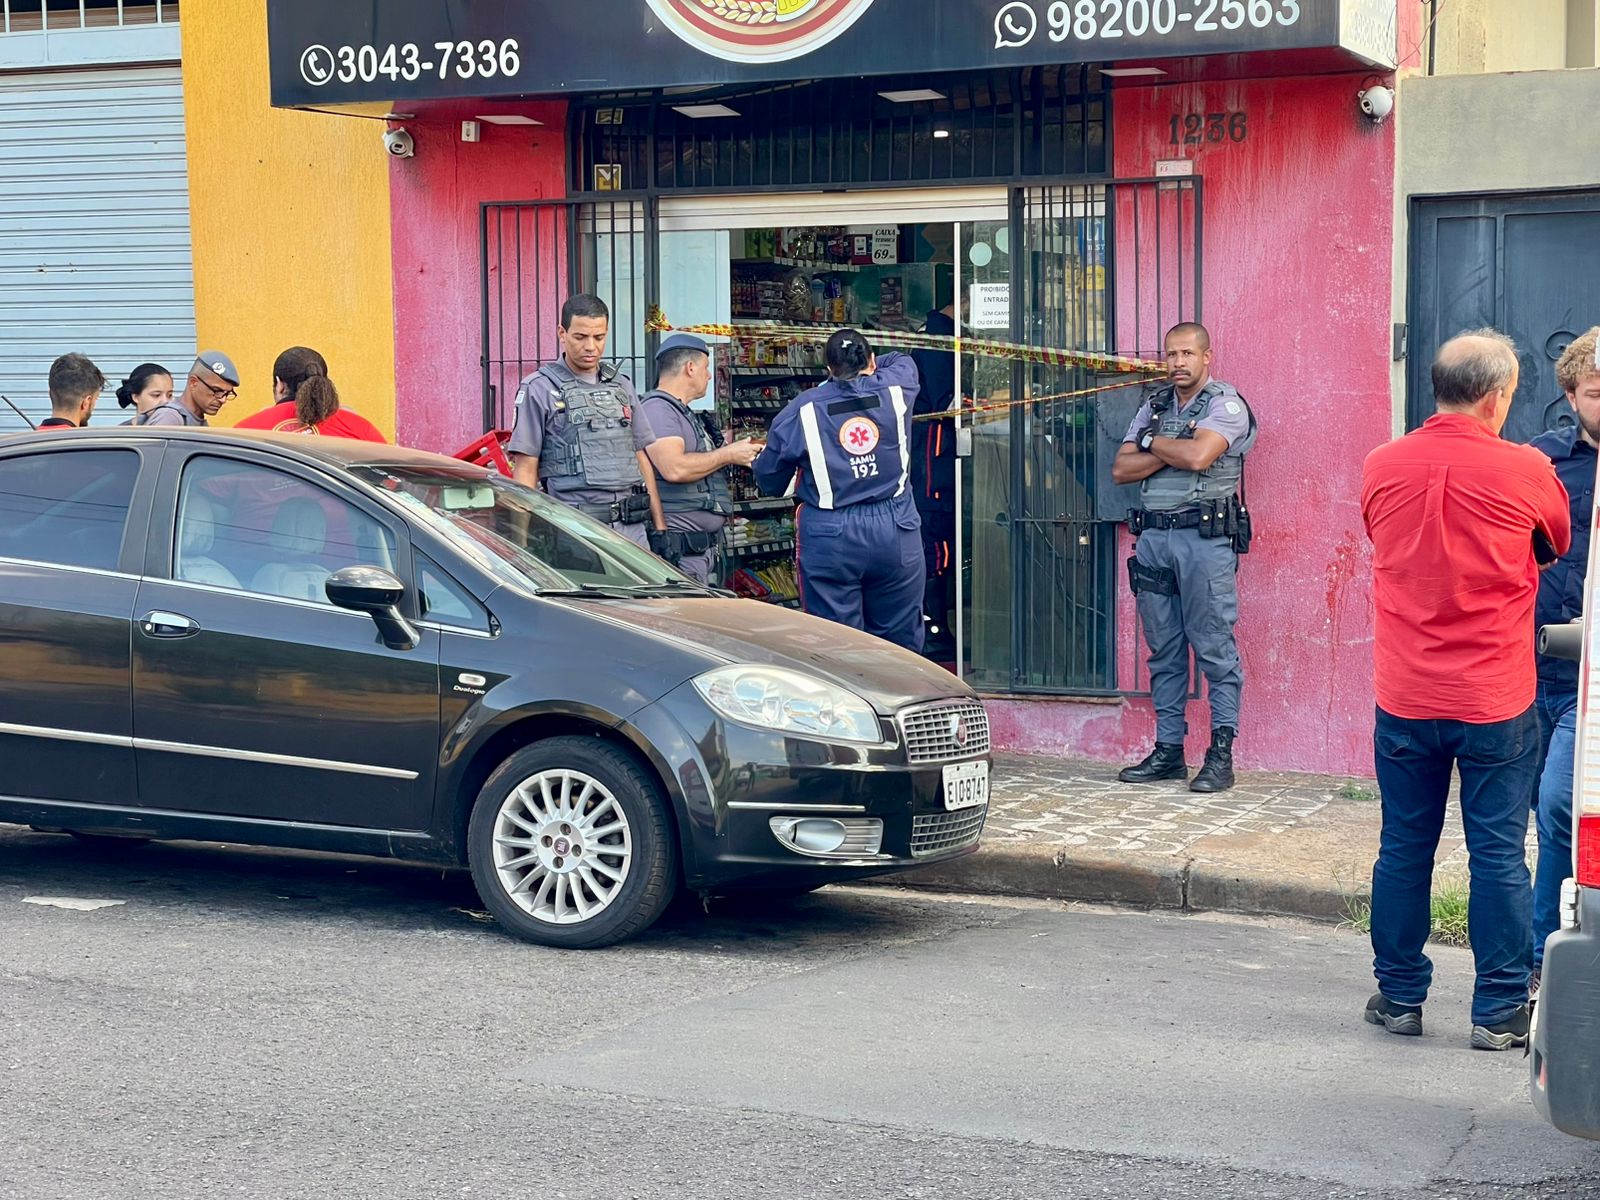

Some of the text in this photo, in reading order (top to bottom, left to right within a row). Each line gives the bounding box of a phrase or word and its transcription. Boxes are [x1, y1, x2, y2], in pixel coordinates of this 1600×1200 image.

[1047, 0, 1300, 42] 98200-2563
[337, 38, 520, 83] 3043-7336
[1169, 113, 1247, 145] 1236
[849, 454, 876, 466] SAMU
[851, 463, 879, 479] 192
